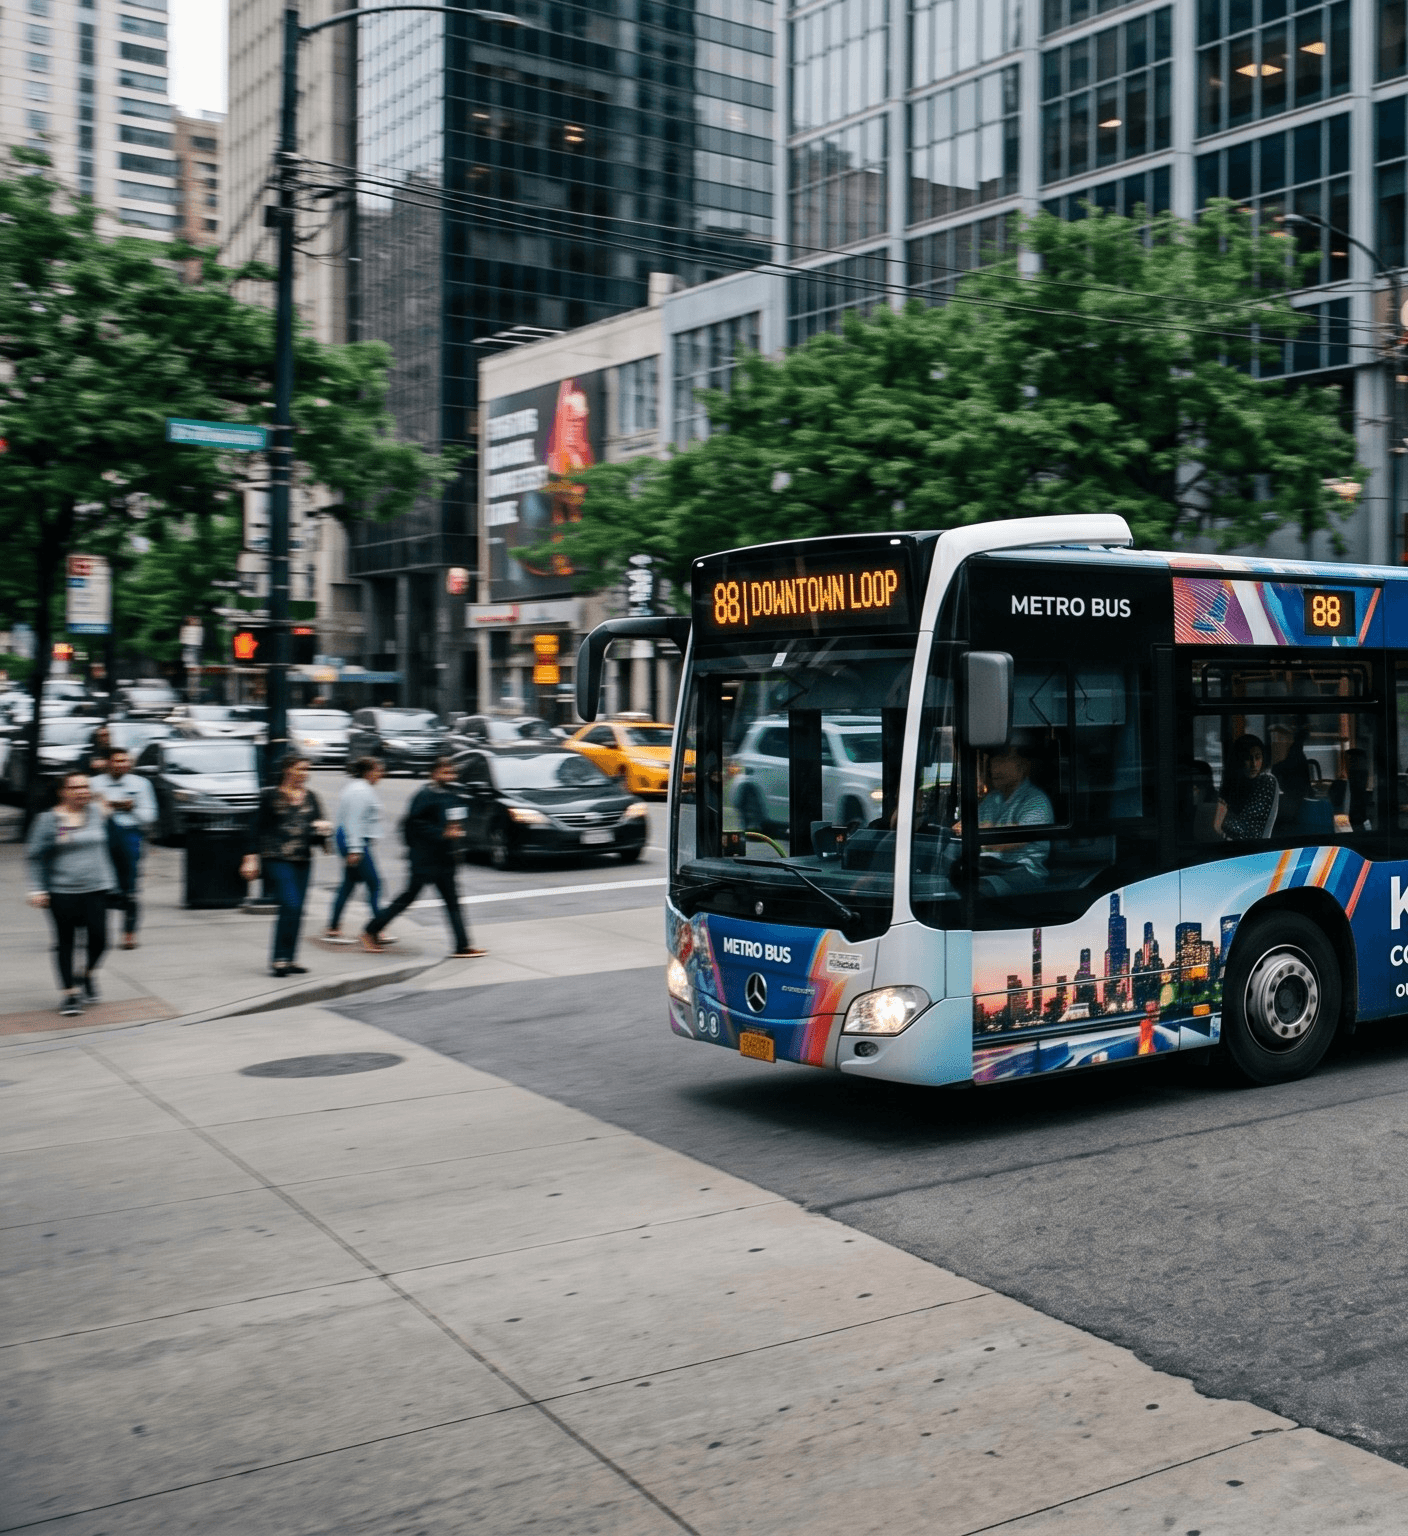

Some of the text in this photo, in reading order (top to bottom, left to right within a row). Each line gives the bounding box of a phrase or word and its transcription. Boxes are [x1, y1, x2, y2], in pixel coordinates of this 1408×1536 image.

[714, 581, 740, 625] 88
[751, 574, 845, 616] DOWNTOWN
[849, 569, 898, 609] LOOP
[1011, 595, 1131, 618] METRO BUS
[1312, 595, 1341, 628] 88
[723, 936, 791, 964] METRO BUS
